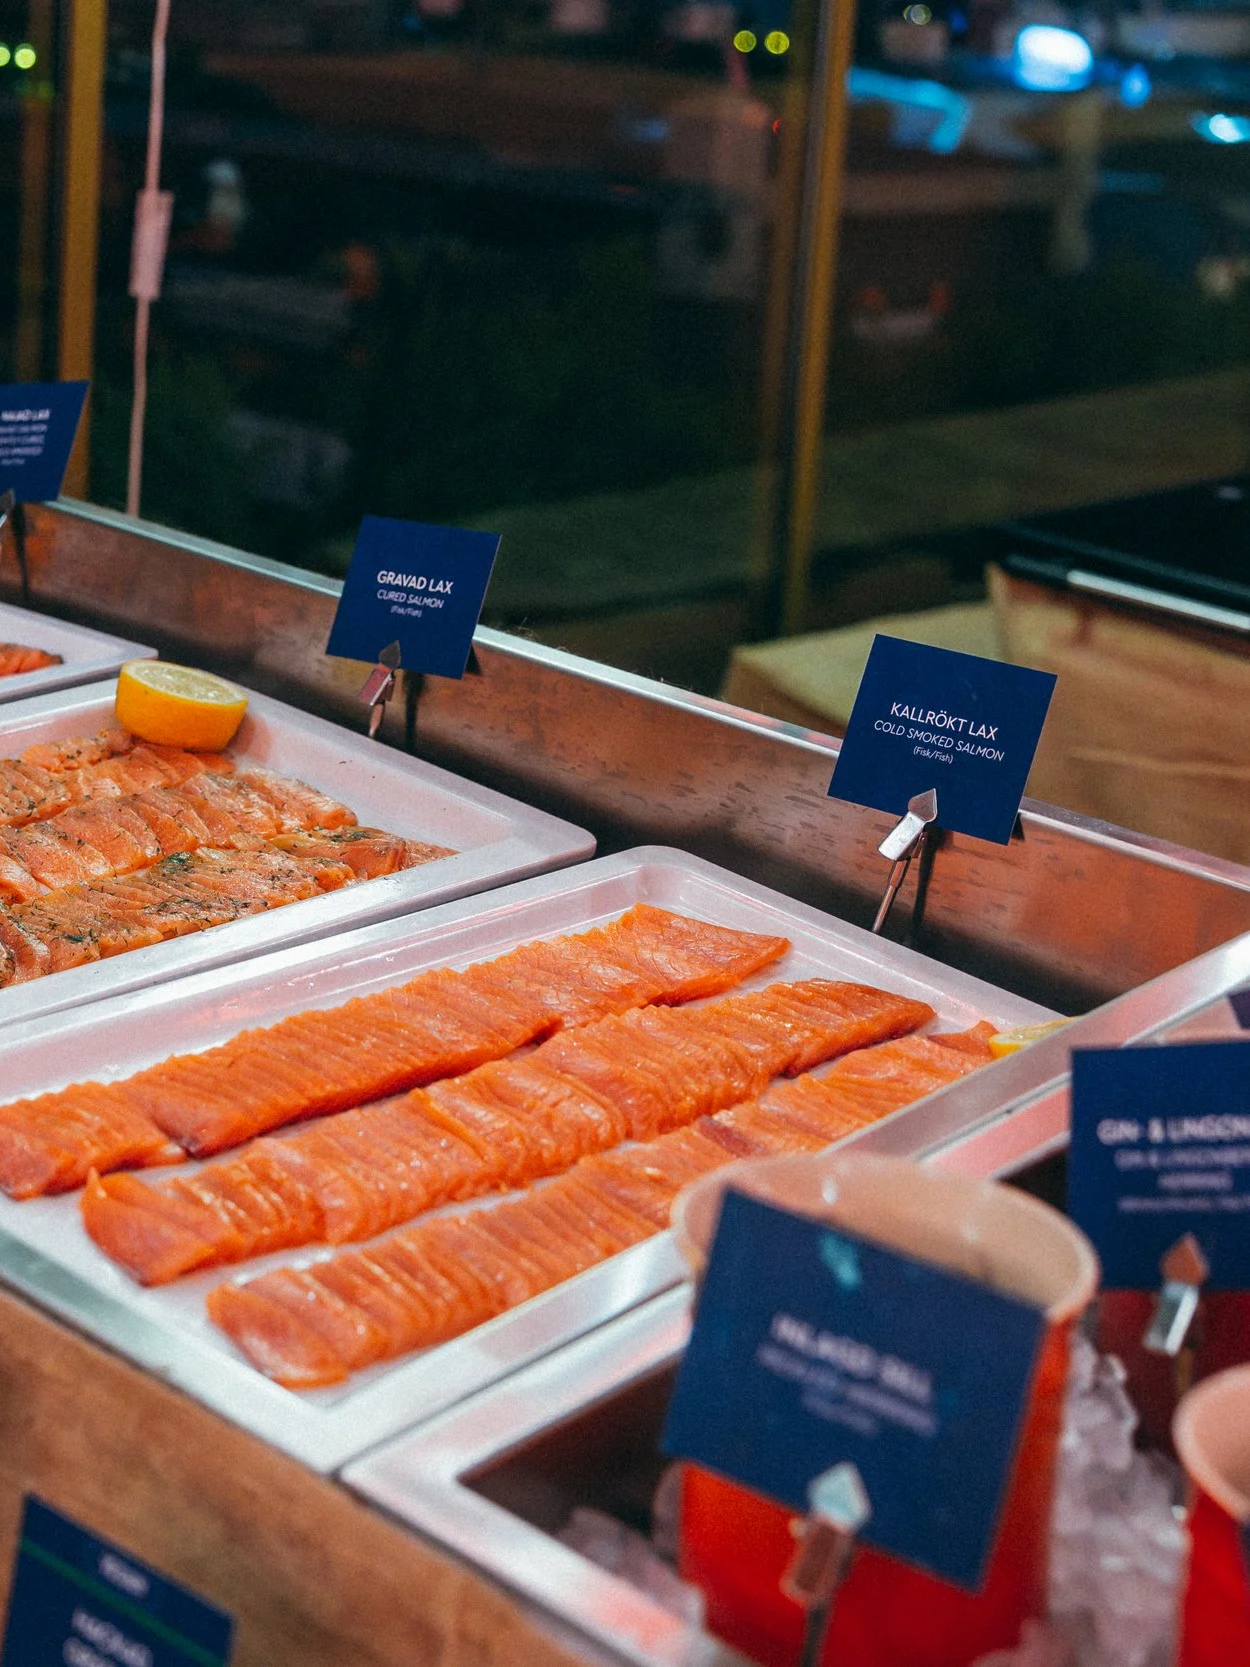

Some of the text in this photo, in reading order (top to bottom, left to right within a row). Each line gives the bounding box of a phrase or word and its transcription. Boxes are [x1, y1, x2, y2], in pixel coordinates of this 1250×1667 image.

[376, 570, 454, 595] GRAVAD LAX
[376, 589, 444, 609] CURED SALMON
[890, 702, 999, 741] KALLRÖKT LAX
[874, 719, 1005, 762] COLD SMOKED SALMON
[913, 745, 954, 764] (Fisk/Fish)
